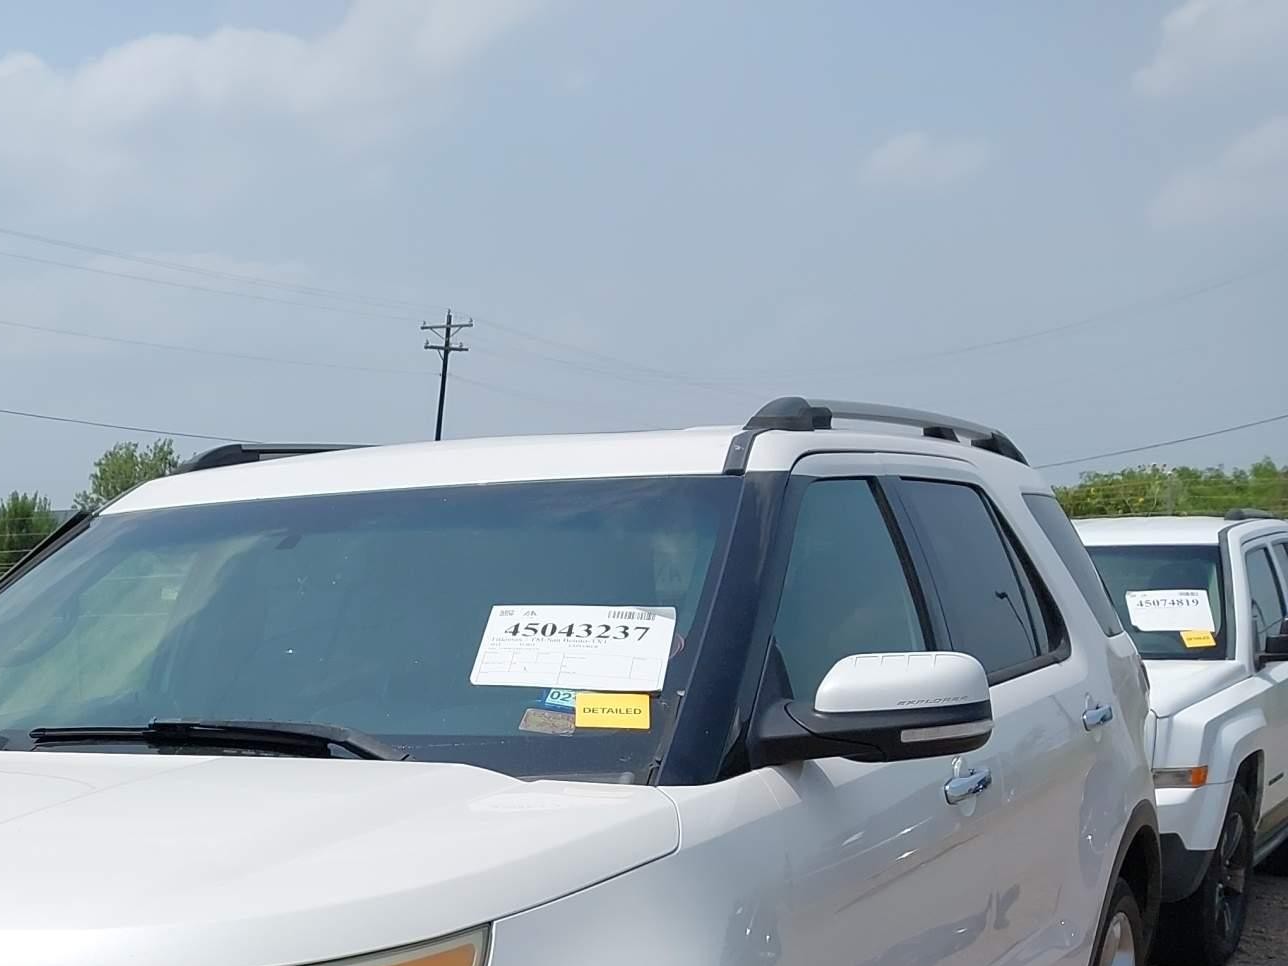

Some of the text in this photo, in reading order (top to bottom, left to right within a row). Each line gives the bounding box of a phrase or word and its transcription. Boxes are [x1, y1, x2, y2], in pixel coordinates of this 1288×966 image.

[1136, 599, 1200, 608] 45074819
[504, 622, 650, 641] 45043237
[583, 707, 642, 715] DETAILED
